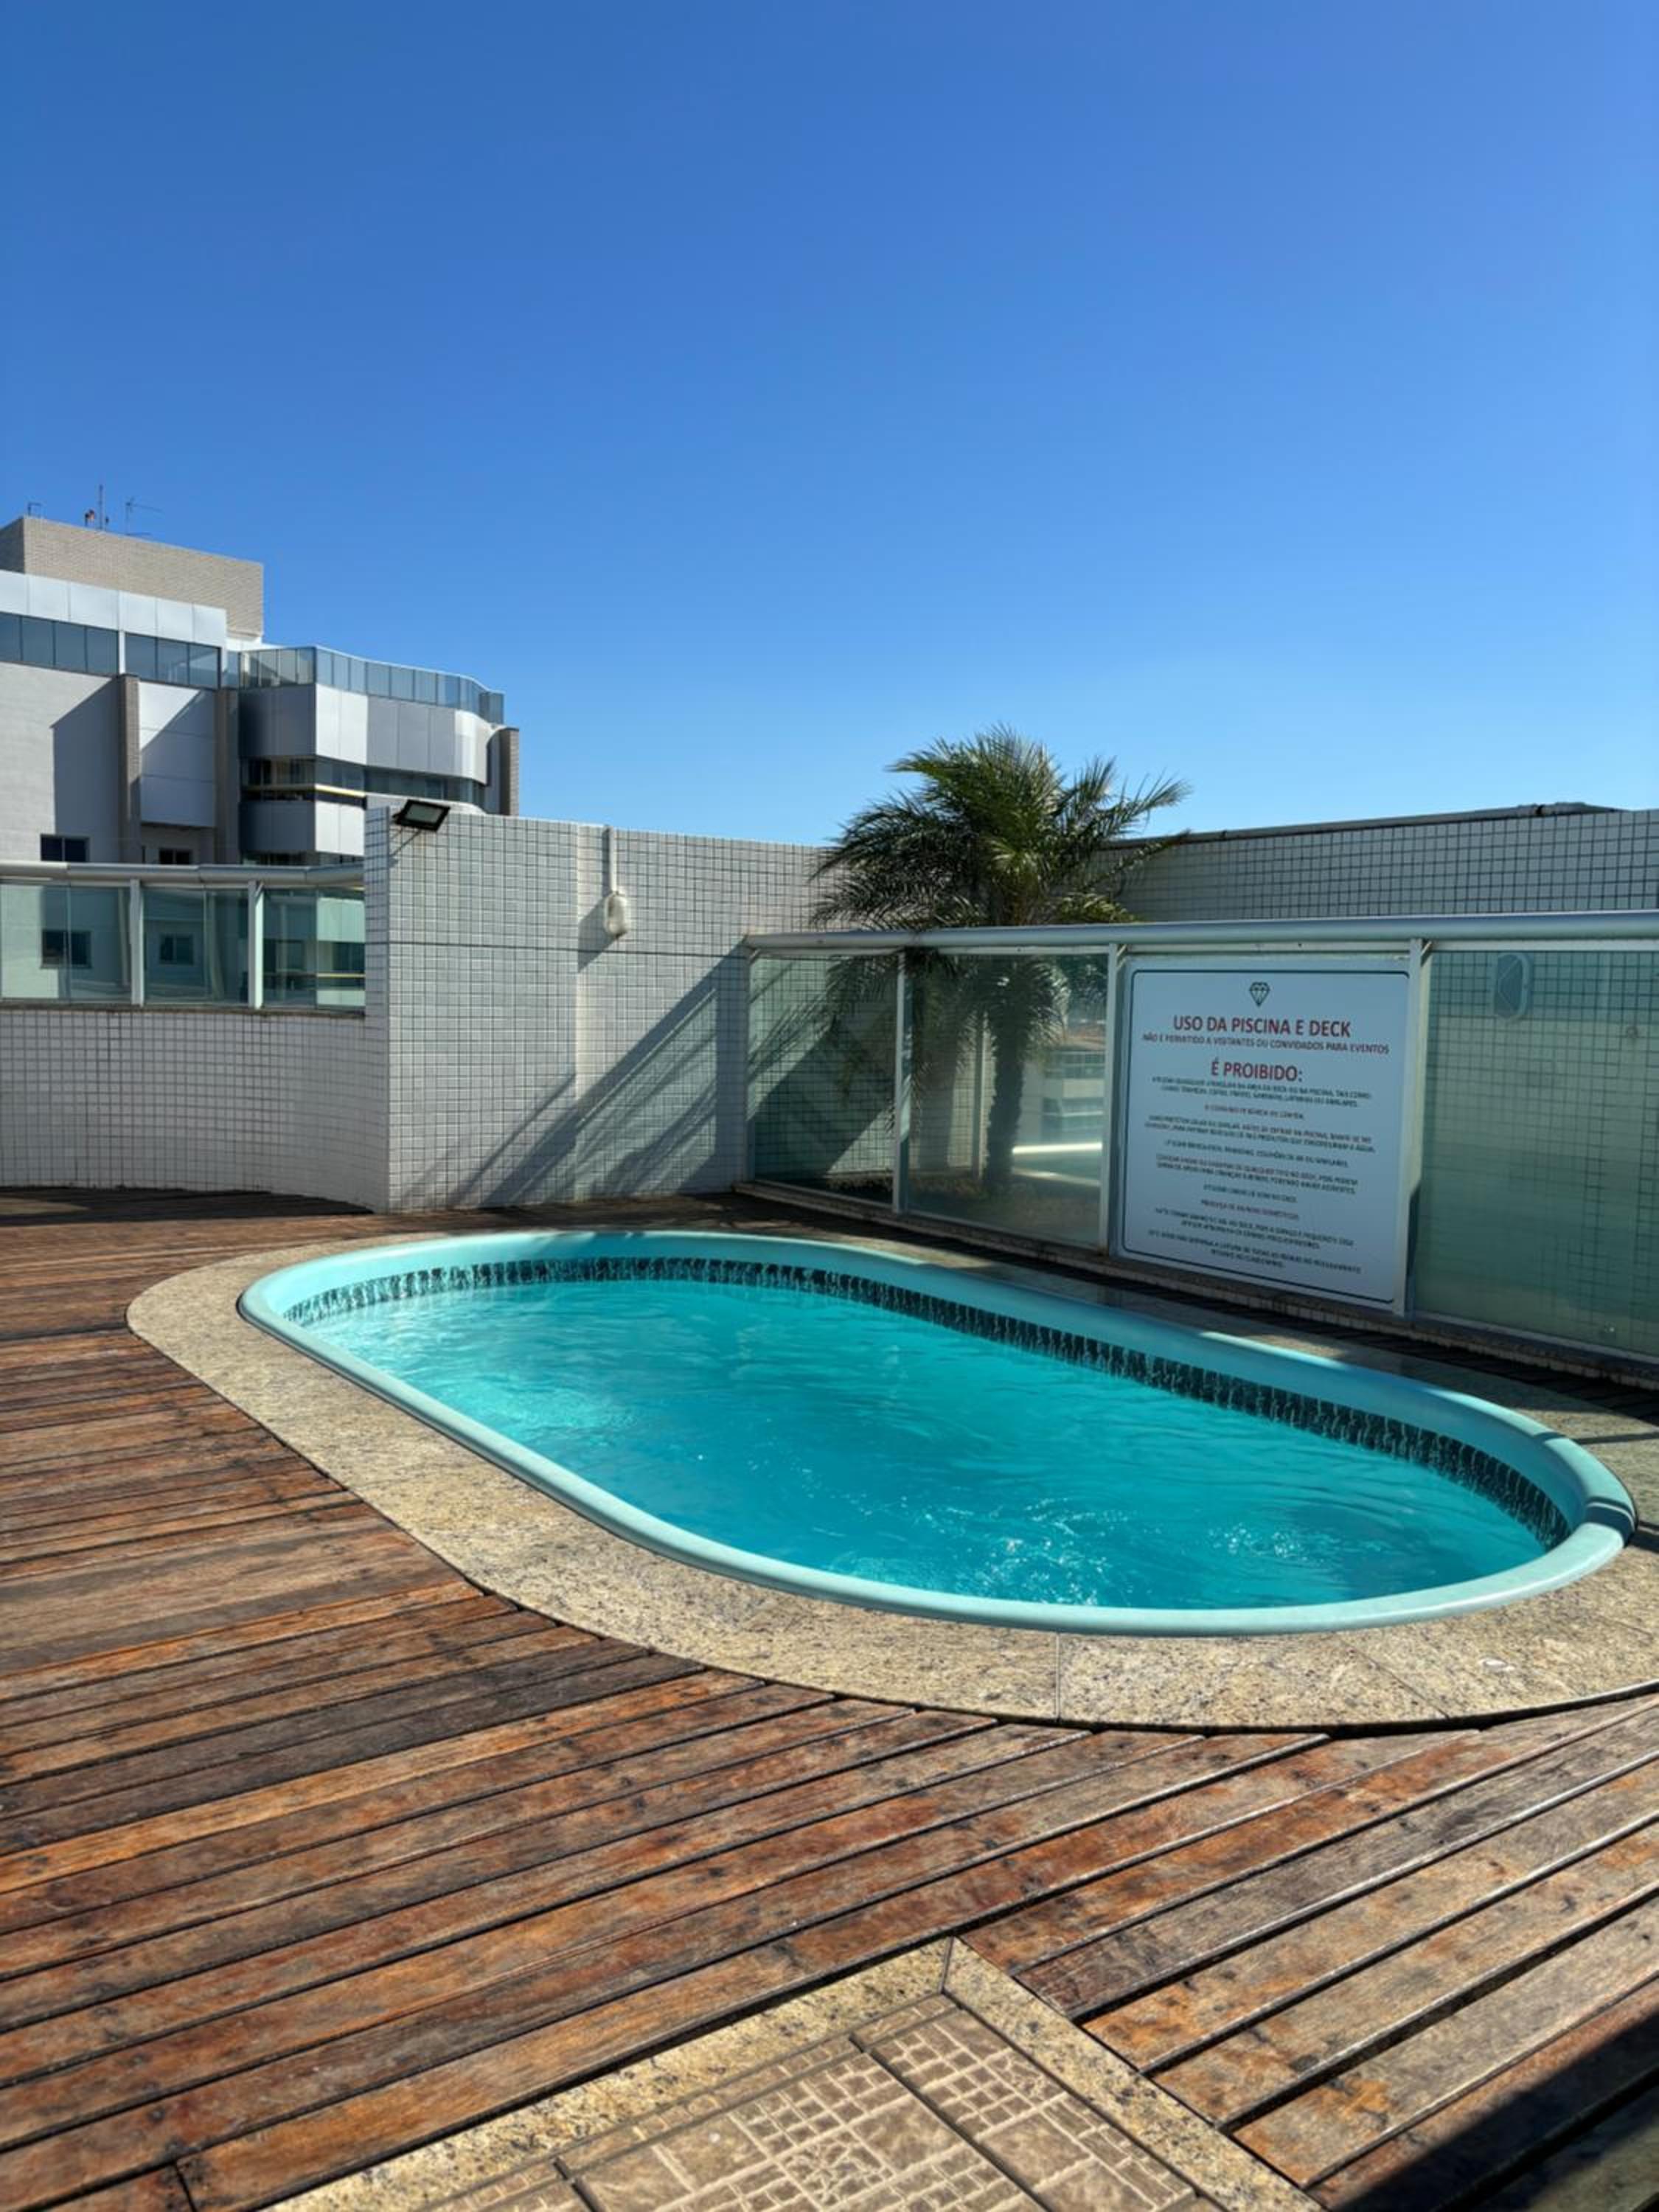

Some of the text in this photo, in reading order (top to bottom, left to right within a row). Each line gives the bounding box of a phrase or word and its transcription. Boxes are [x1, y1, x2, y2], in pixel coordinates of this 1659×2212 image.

[1174, 1015, 1351, 1037] USO DA PISCINA E DECK
[1270, 1039, 1324, 1051] CONVIDADOS
[1223, 1062, 1303, 1082] PROIBIDO:
